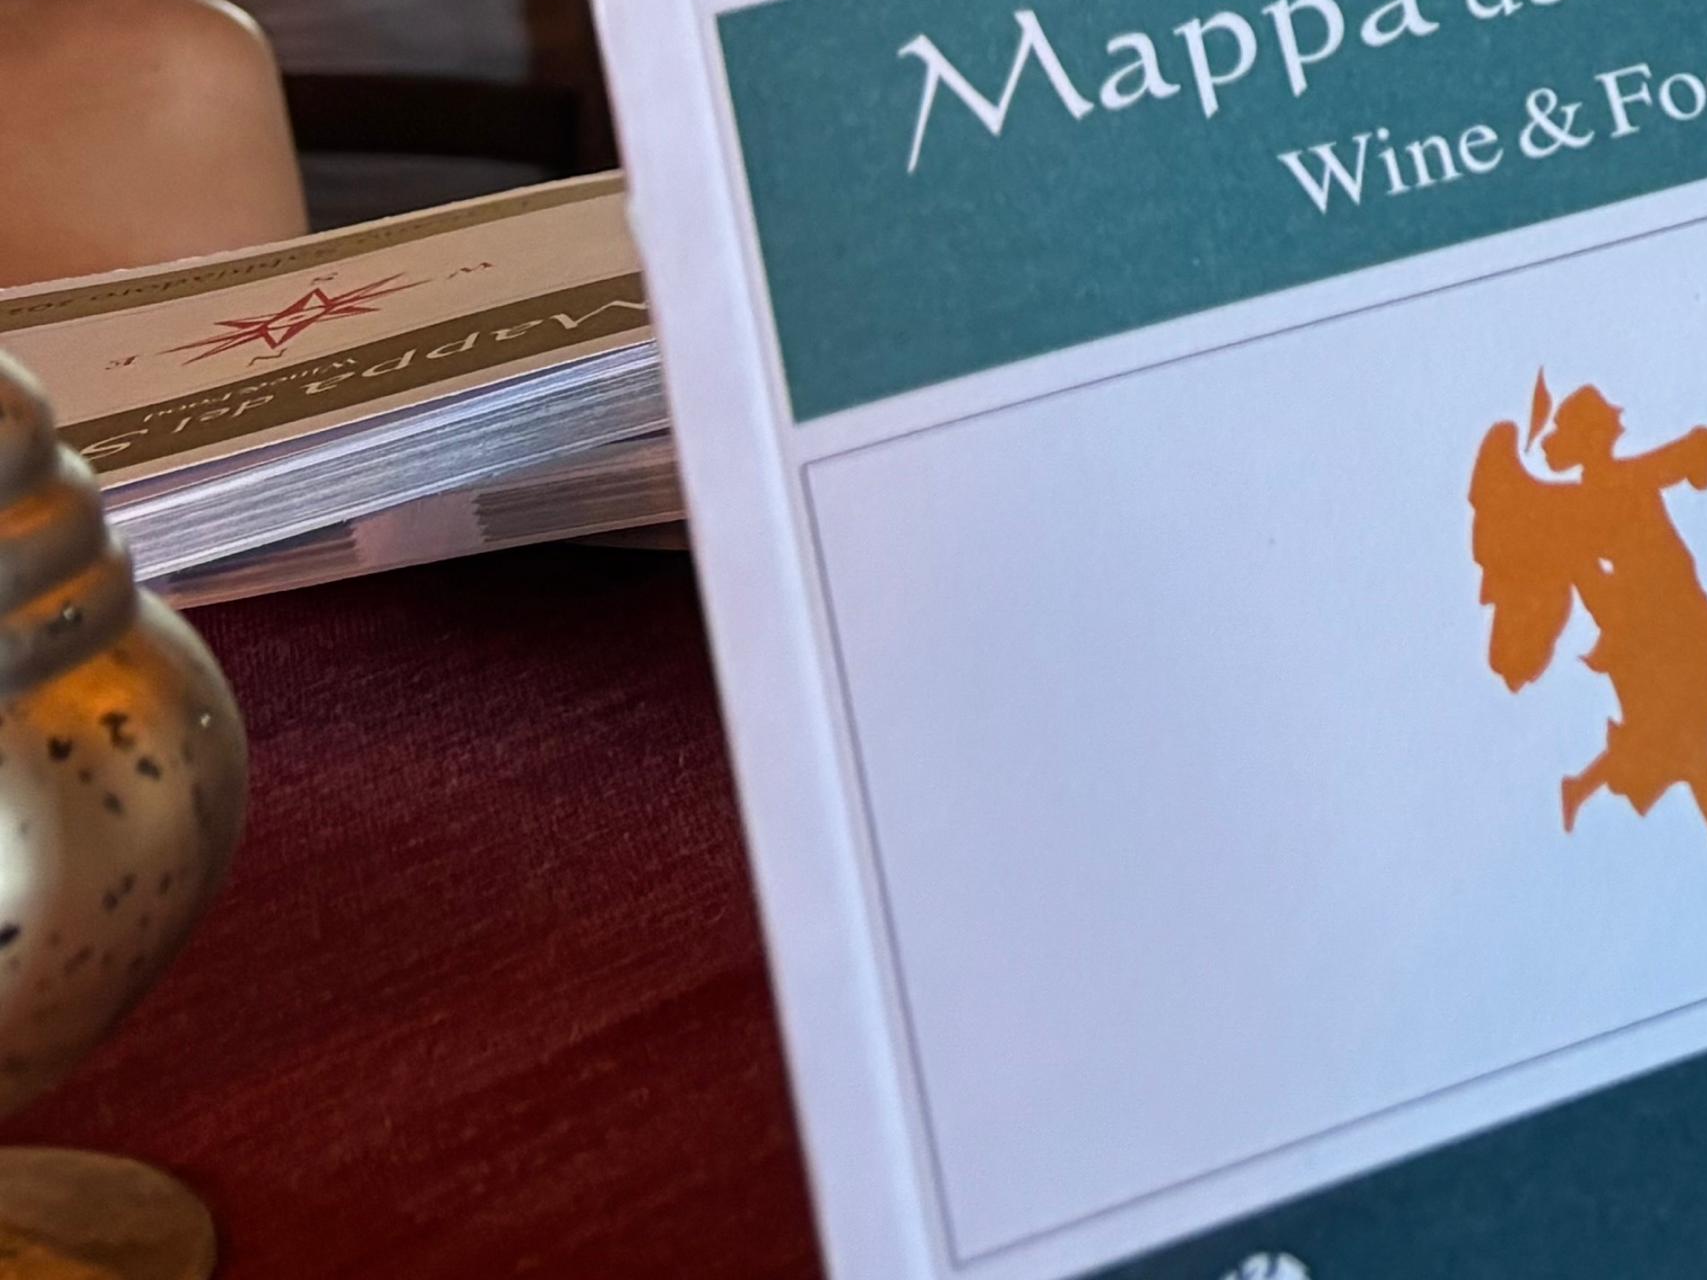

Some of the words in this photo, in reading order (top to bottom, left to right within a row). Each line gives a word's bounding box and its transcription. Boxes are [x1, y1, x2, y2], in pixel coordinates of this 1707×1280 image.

[1276, 121, 1504, 215] Wine
[1518, 87, 1595, 160] &
[172, 394, 275, 434] del
